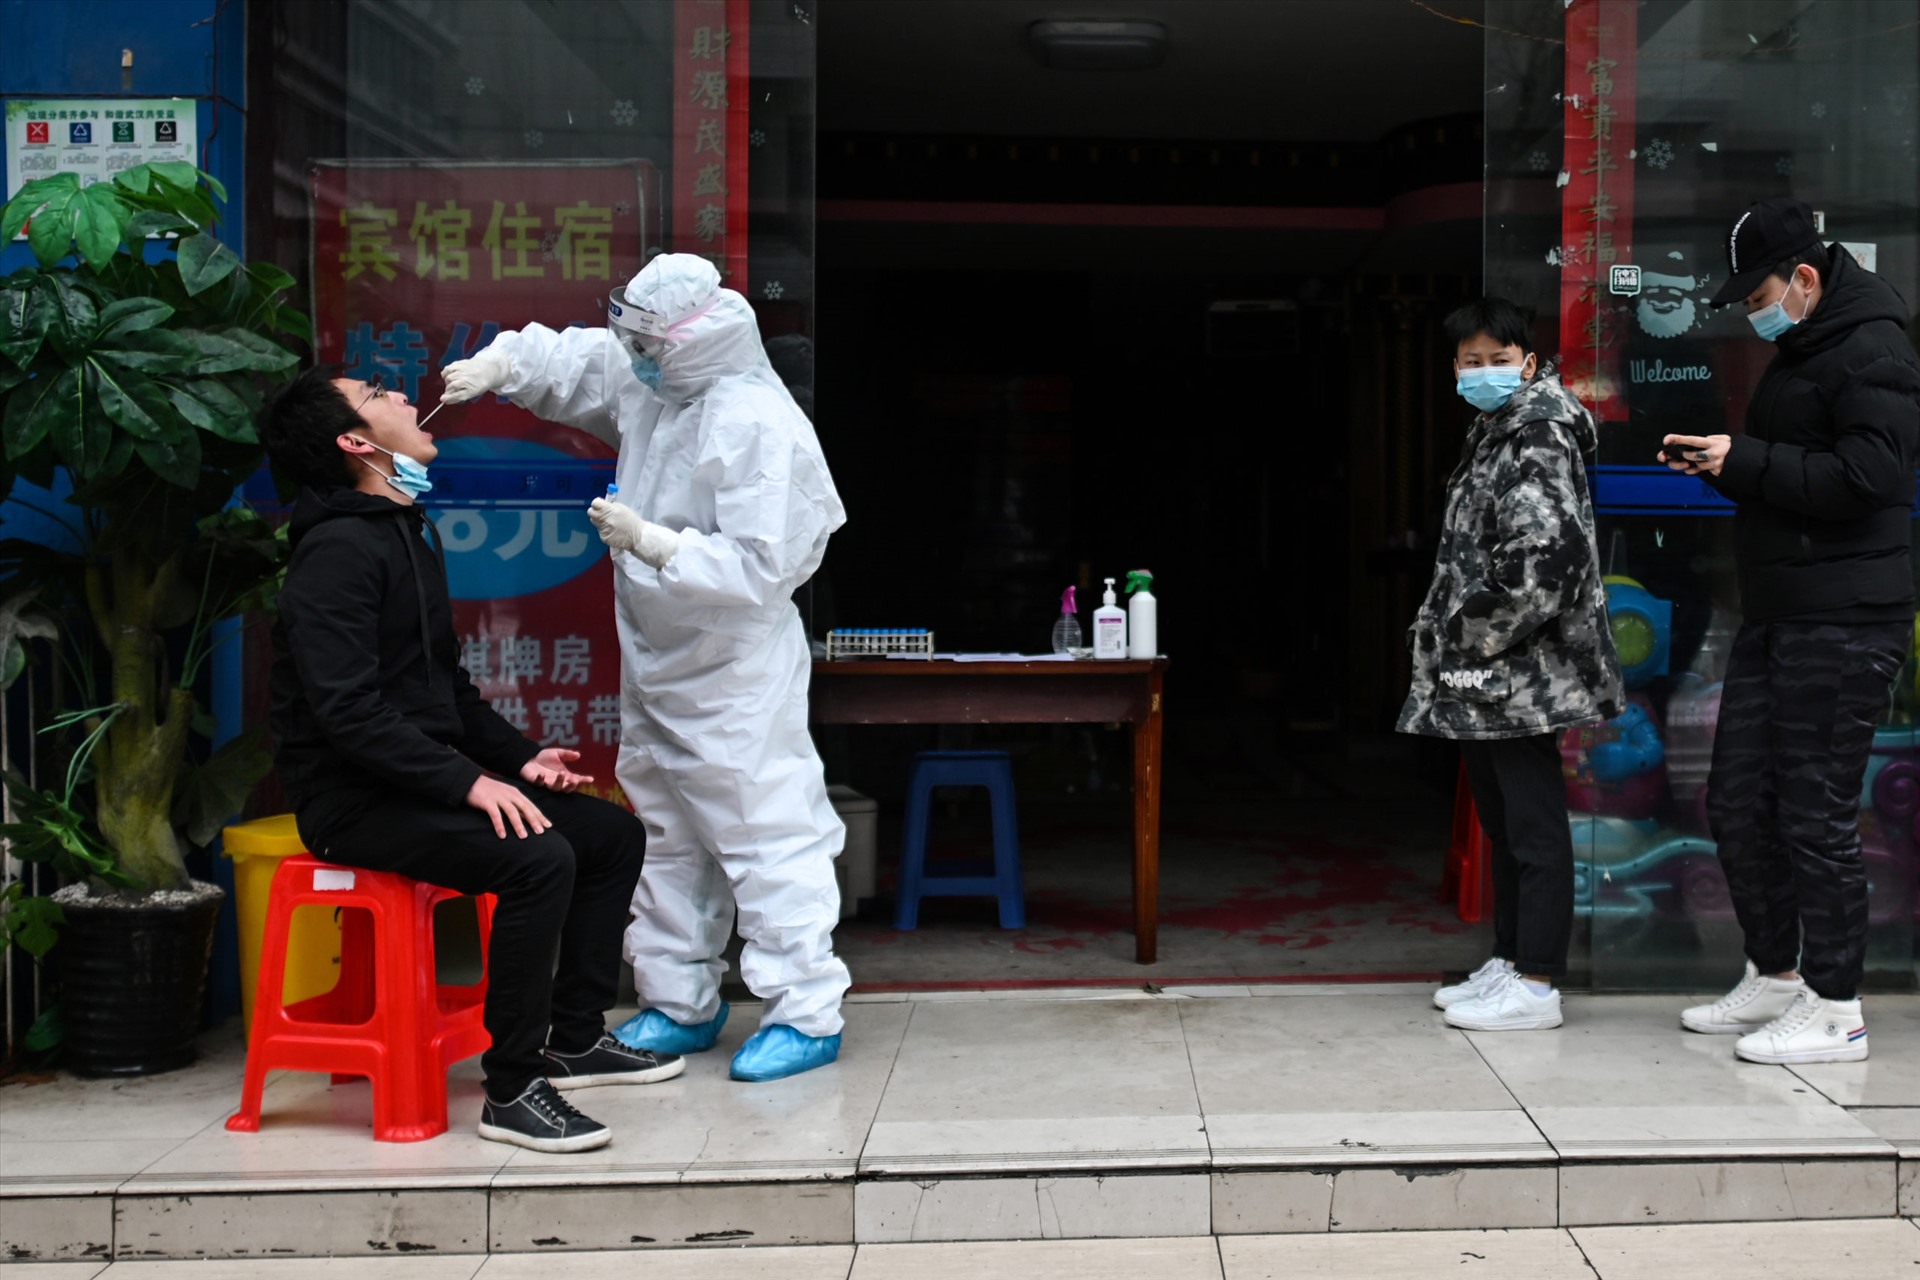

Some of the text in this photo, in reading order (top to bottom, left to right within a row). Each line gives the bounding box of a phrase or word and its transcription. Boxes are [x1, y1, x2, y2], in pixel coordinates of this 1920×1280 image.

[688, 23, 732, 276] 財源茂盛家
[338, 199, 614, 281] 宾馆住宿
[1630, 358, 1712, 384] Welcome
[420, 500, 589, 561] 8元
[459, 633, 592, 686] 棋牌房
